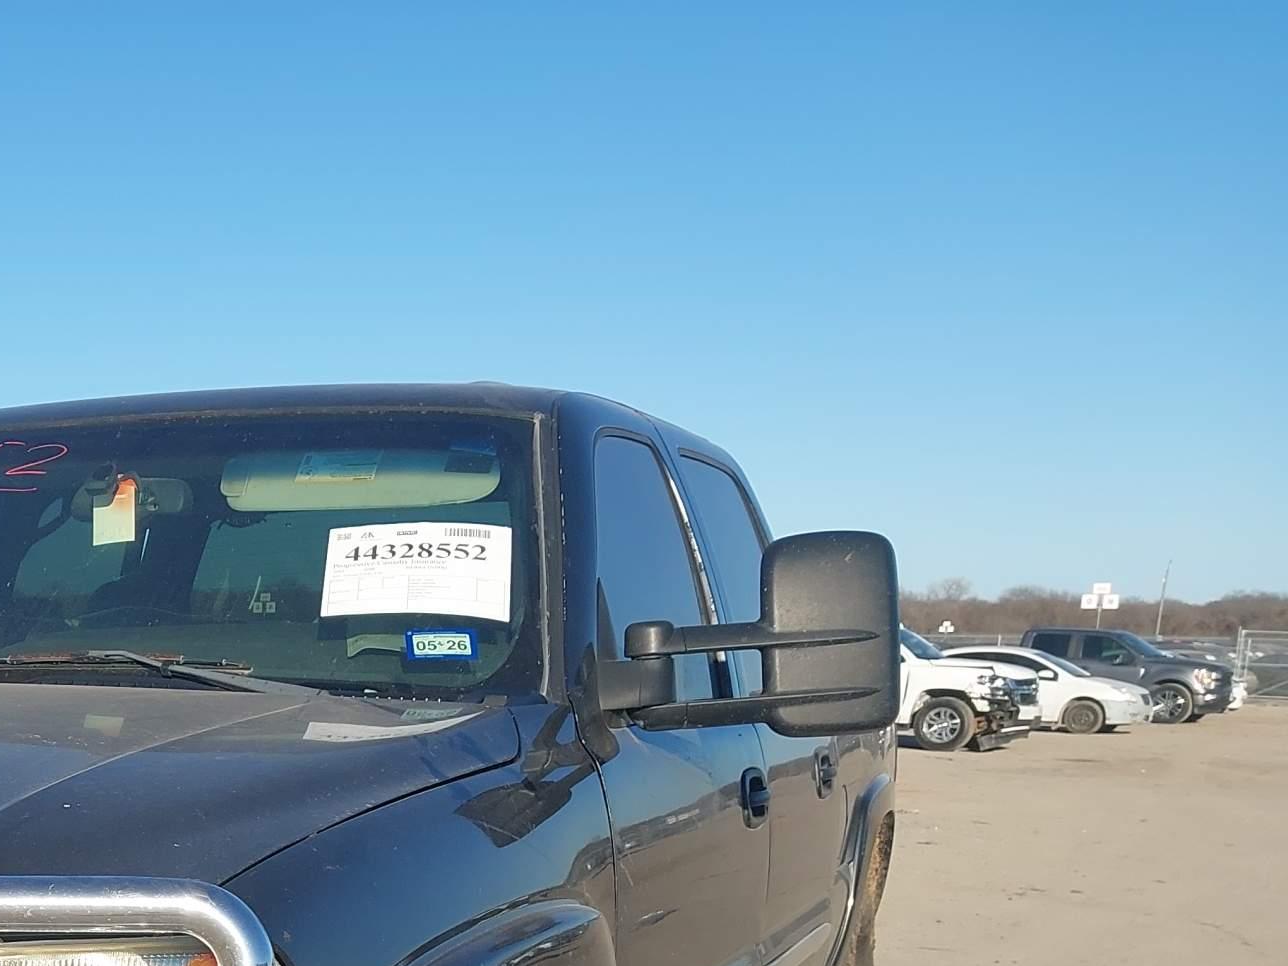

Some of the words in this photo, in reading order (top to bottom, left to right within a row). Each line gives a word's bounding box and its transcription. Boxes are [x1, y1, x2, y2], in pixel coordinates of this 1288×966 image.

[345, 542, 487, 561] 44328552
[416, 640, 438, 651] 05
[446, 640, 467, 651] 26
